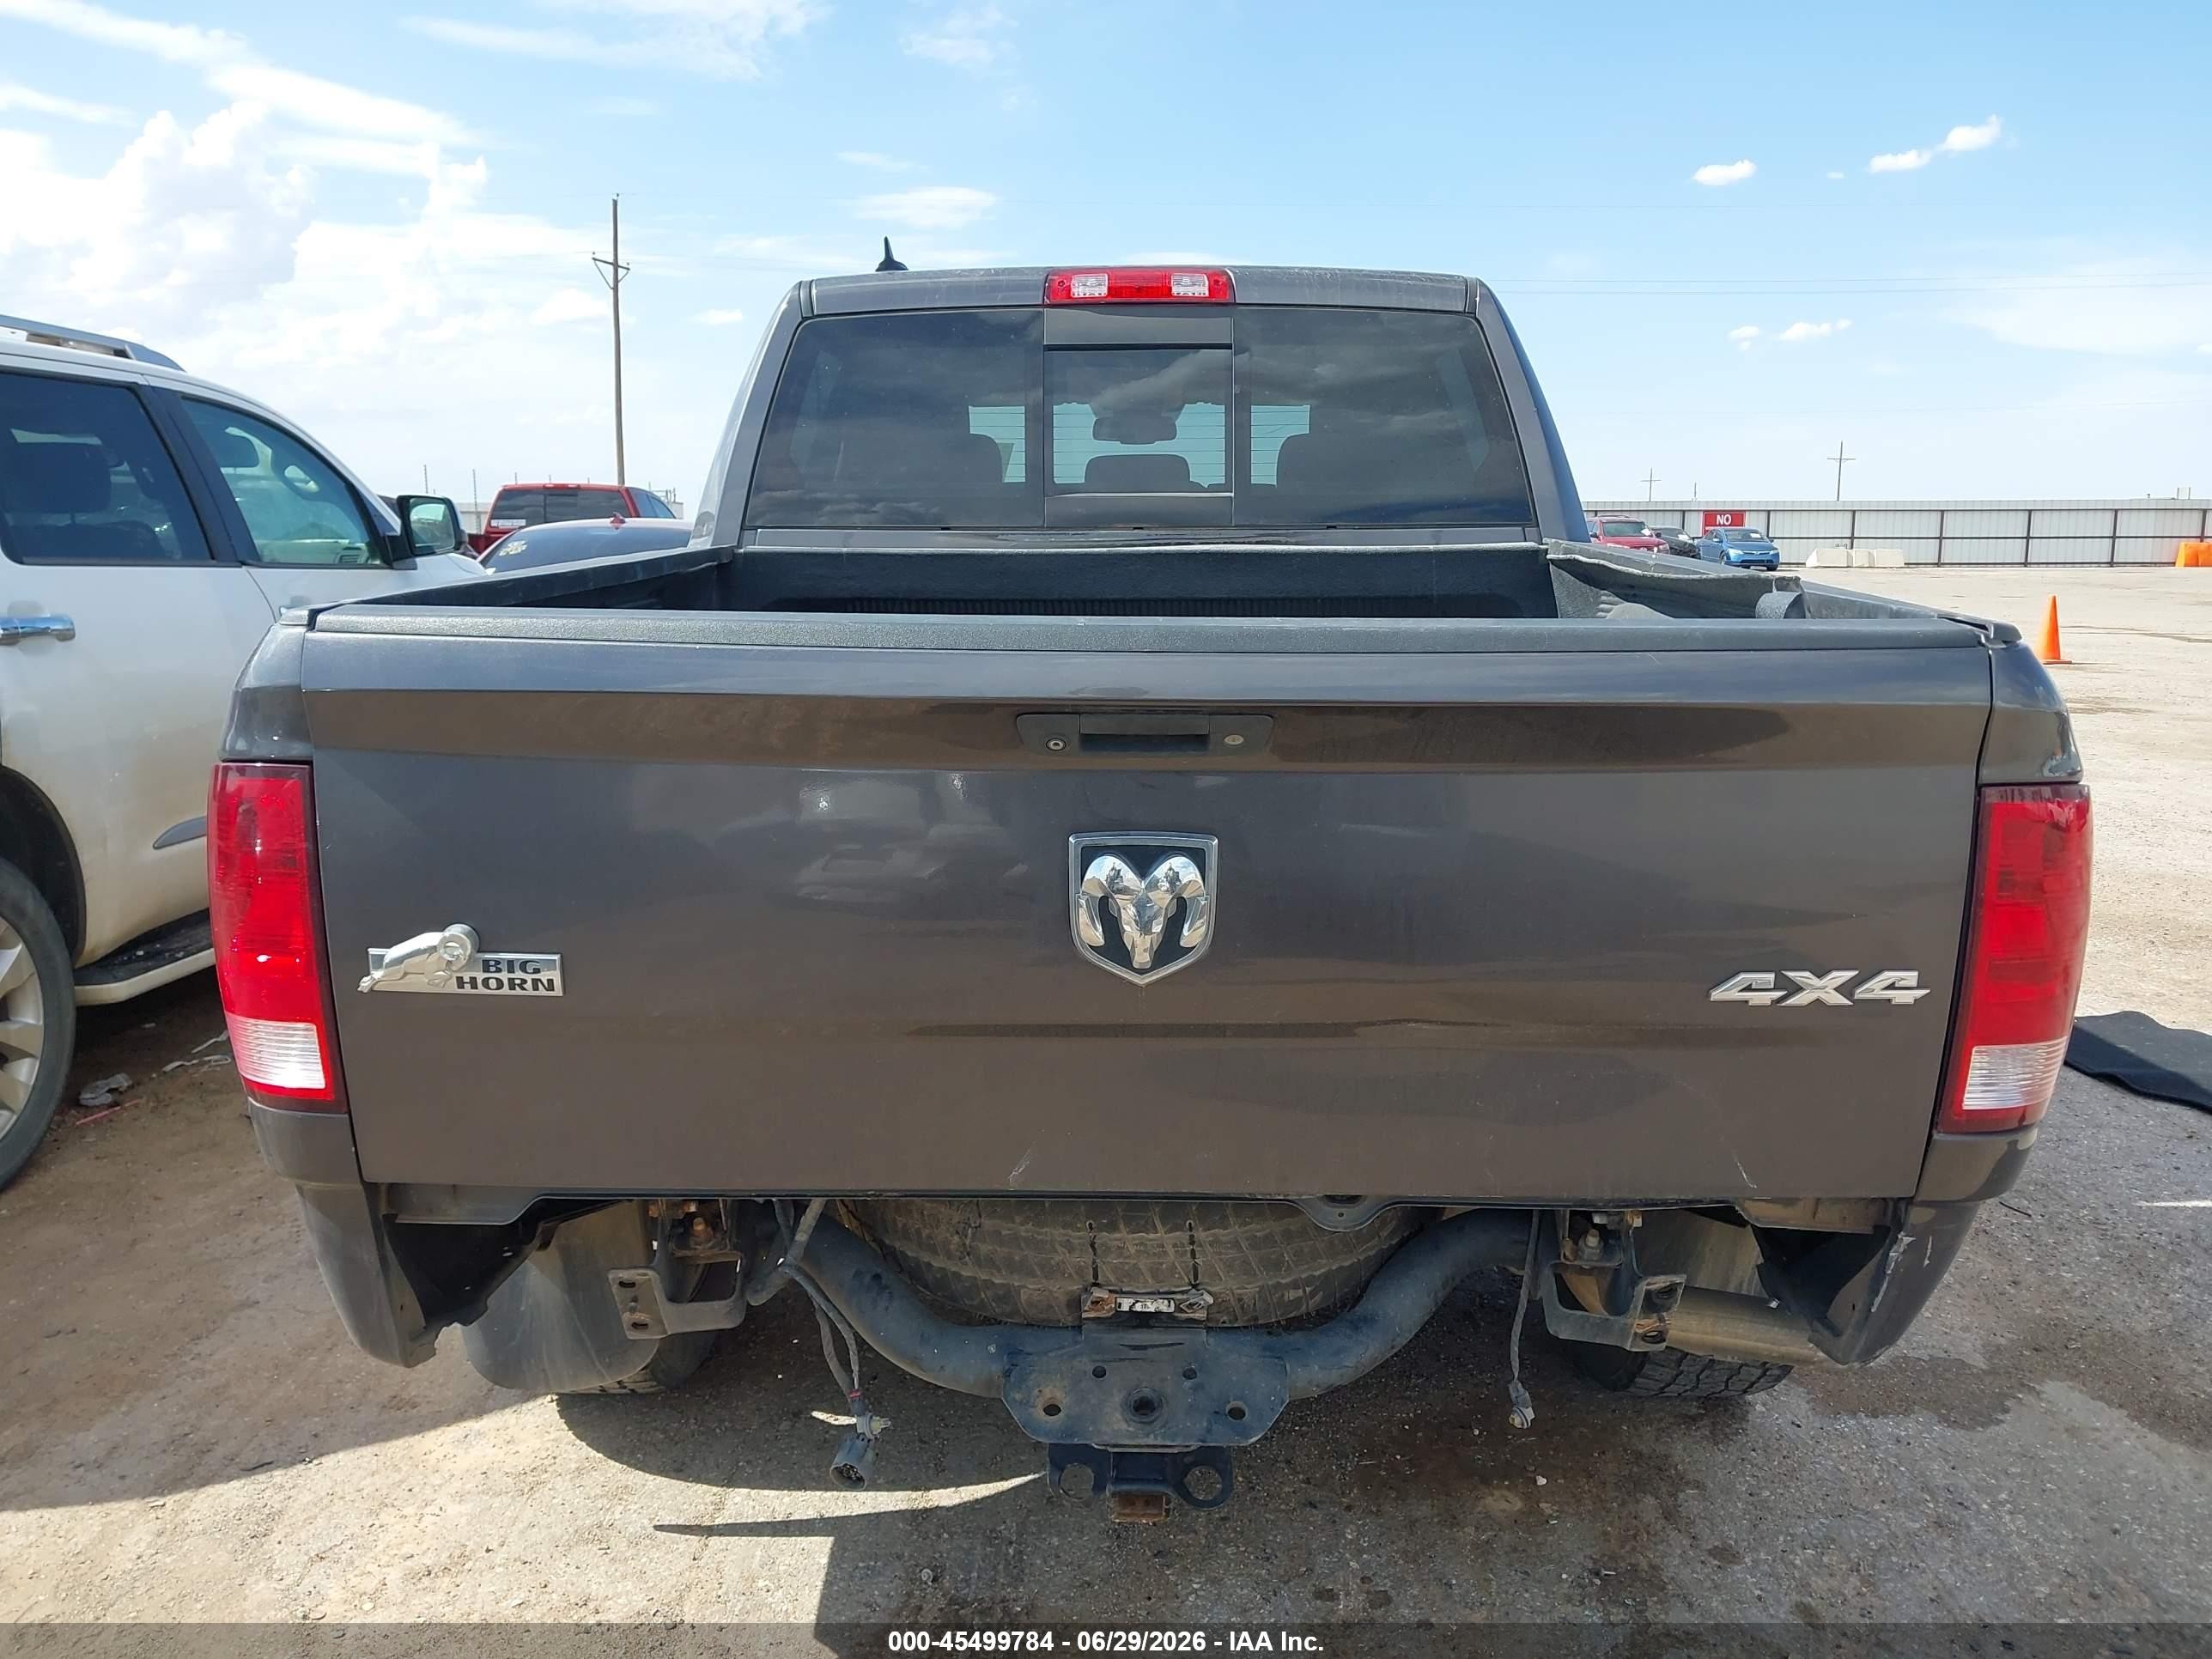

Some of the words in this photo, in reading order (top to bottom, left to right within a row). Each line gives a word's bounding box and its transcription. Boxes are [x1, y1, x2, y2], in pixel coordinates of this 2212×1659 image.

[1717, 514, 1731, 526] NO
[481, 959, 542, 975] BIG
[455, 975, 555, 992] HORN
[1709, 969, 1931, 1006] 4X4
